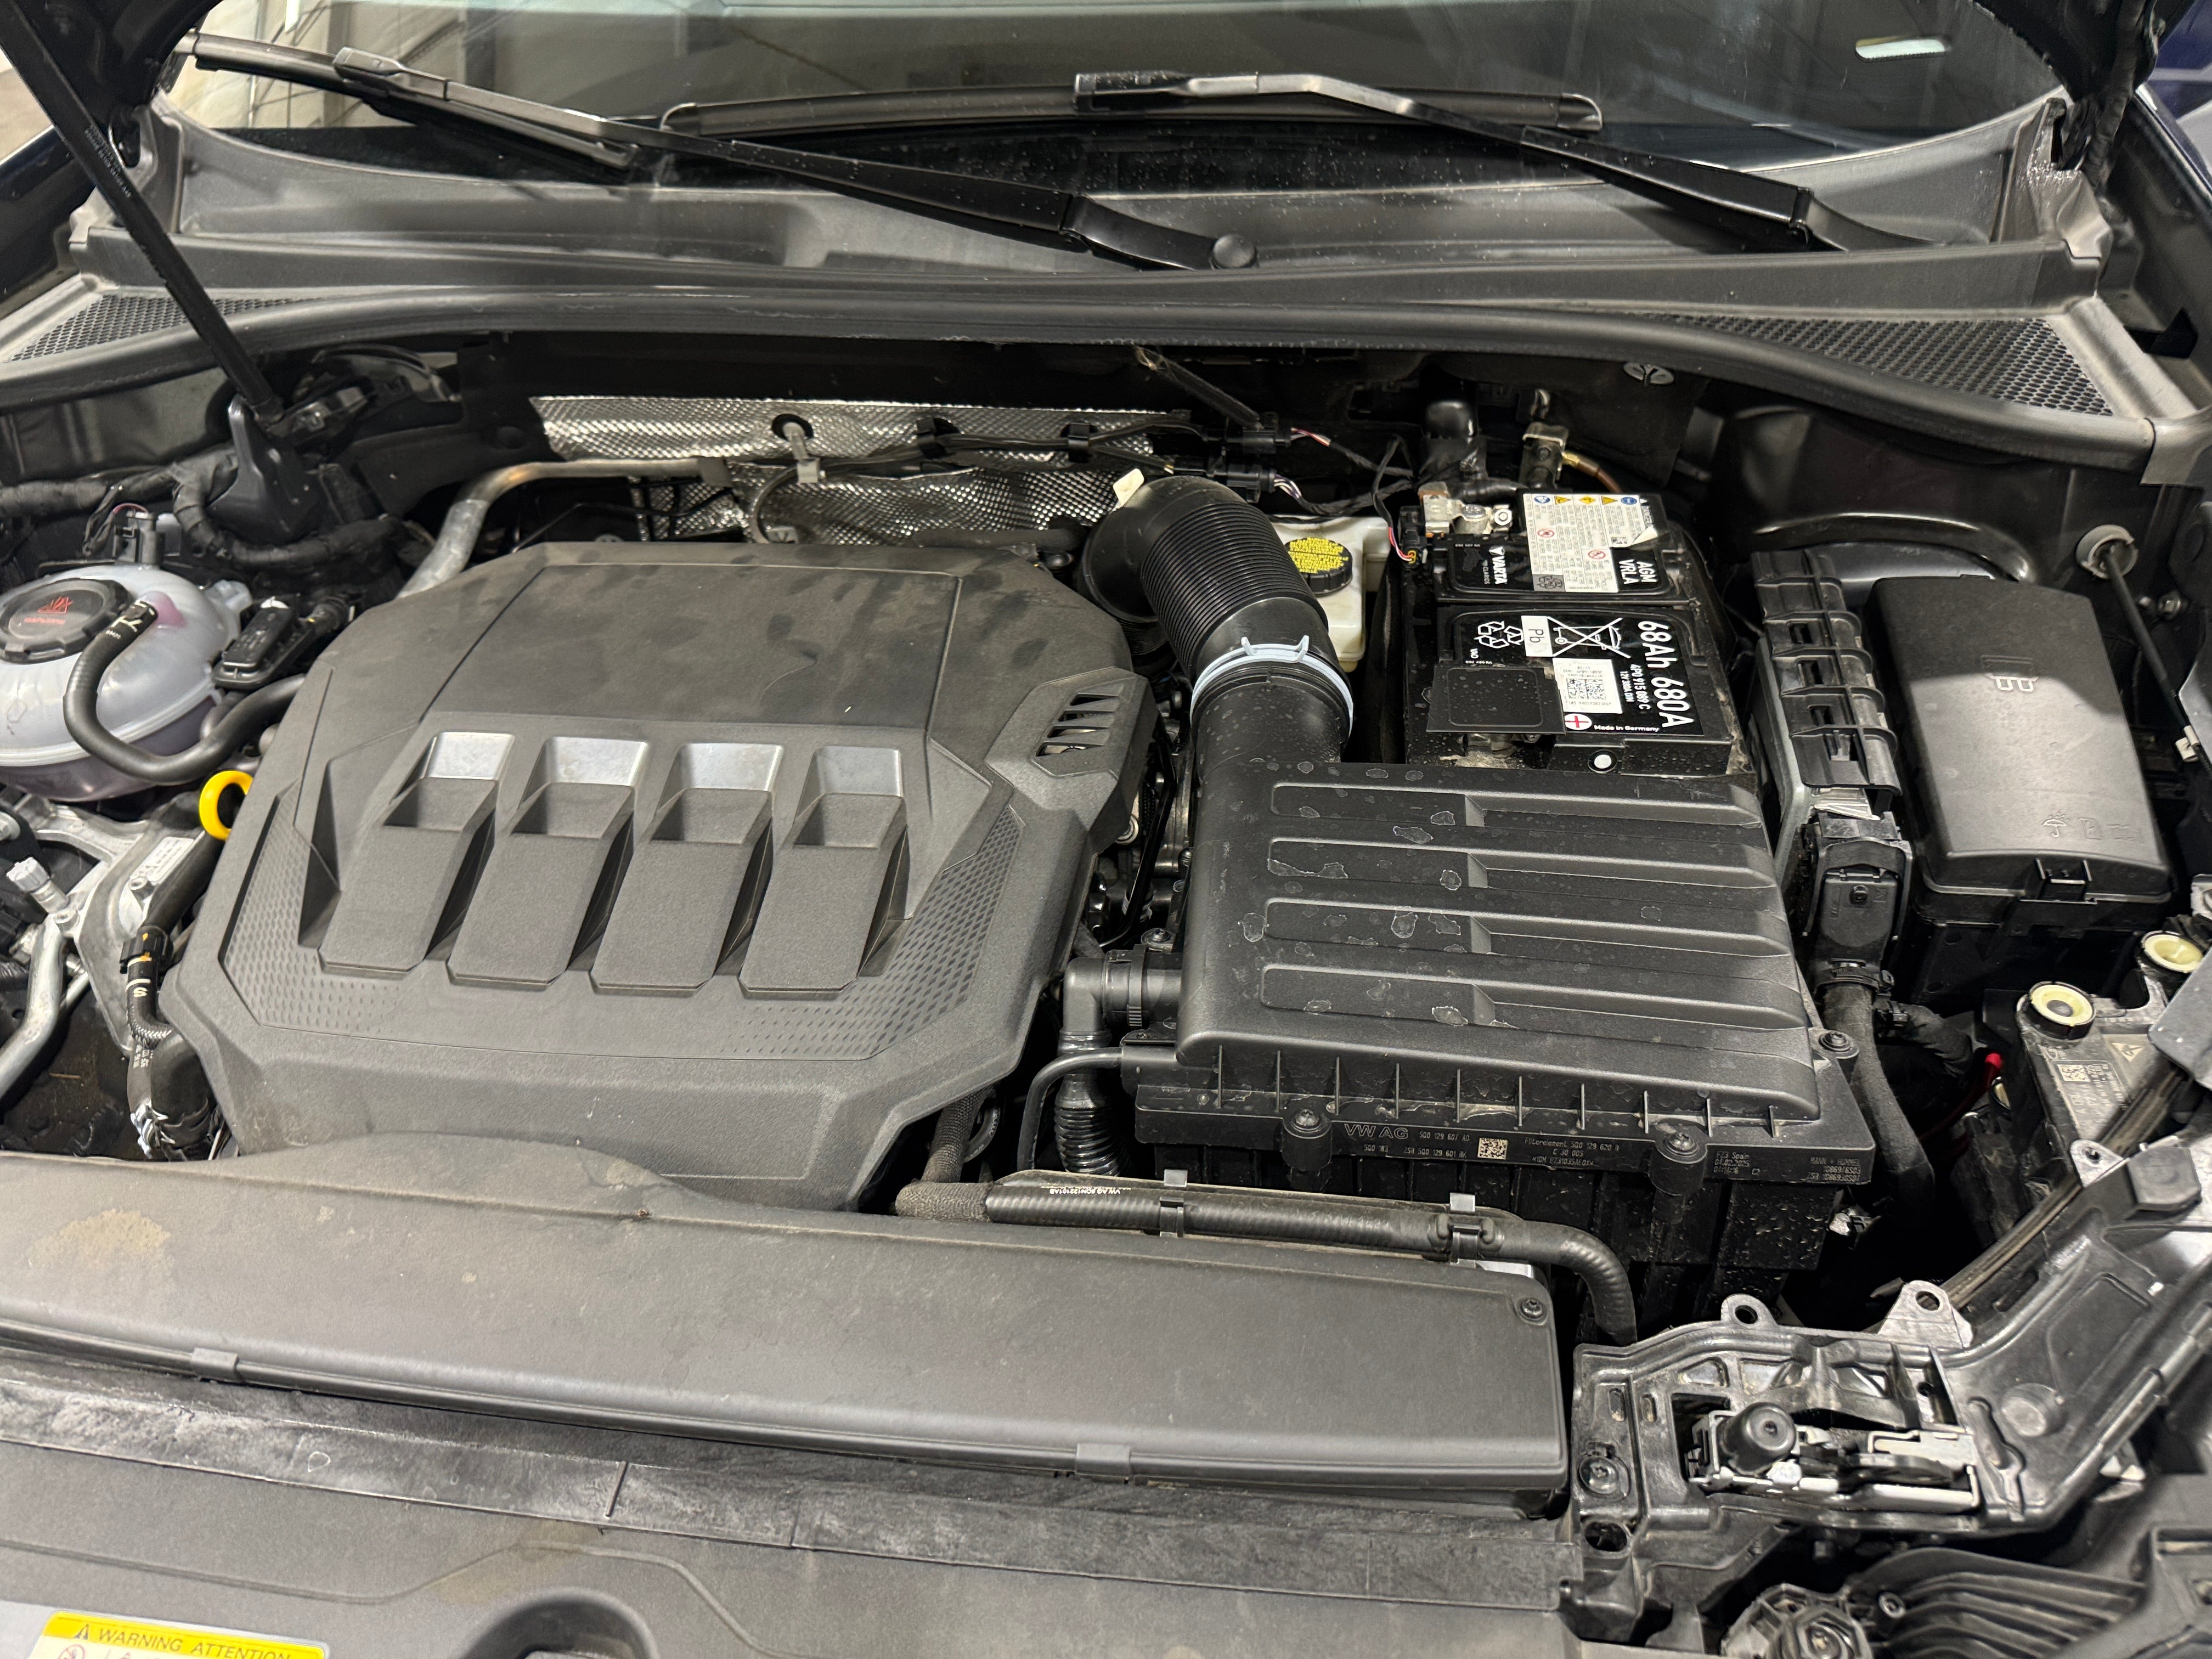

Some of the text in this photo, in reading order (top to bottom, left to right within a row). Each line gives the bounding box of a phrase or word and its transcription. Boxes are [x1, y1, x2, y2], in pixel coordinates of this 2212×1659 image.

[1492, 556, 1508, 584] VARTA
[1618, 558, 1639, 584] VRLA
[1637, 561, 1658, 583] AGM
[1529, 628, 1545, 644] Pb
[1620, 671, 1629, 680] 12V
[1630, 664, 1644, 677] 4P0
[1638, 620, 1694, 728] 68Ah 680A
[1632, 678, 1646, 690] 915
[1624, 692, 1634, 702] DIN
[1635, 691, 1649, 703] 089
[1344, 1123, 1409, 1139] VW AG
[1571, 1149, 1584, 1158] 005
[98, 1627, 182, 1652] WARNING
